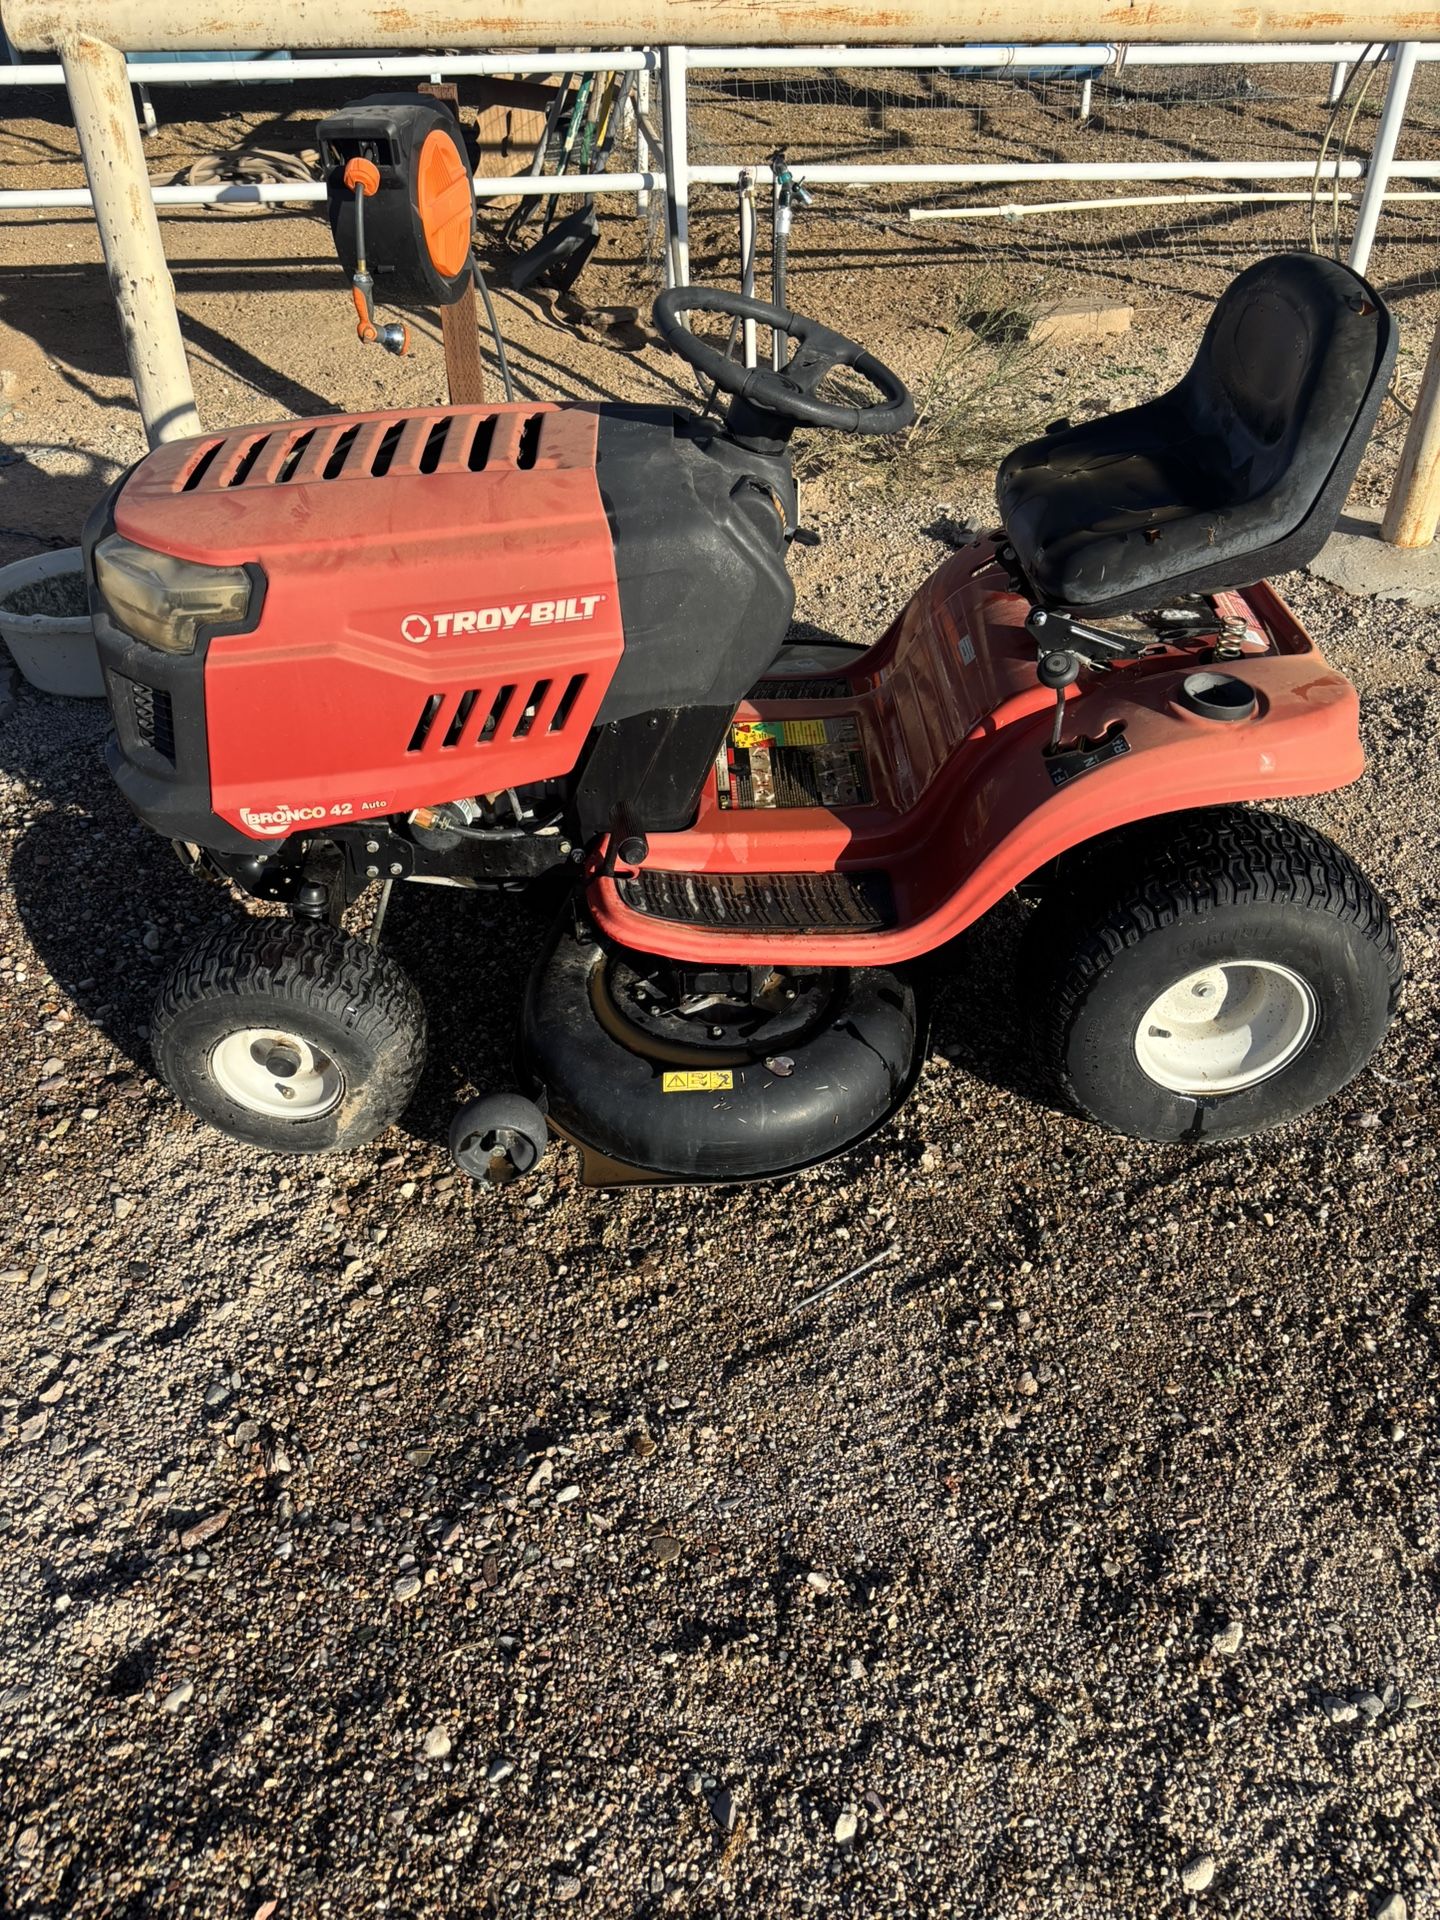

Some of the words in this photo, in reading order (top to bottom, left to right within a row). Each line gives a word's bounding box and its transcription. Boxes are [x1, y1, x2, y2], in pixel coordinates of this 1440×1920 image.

[433, 595, 601, 637] TROY-BILT
[248, 806, 326, 825] BRONCO
[330, 803, 353, 815] 42
[361, 800, 388, 810] Auto
